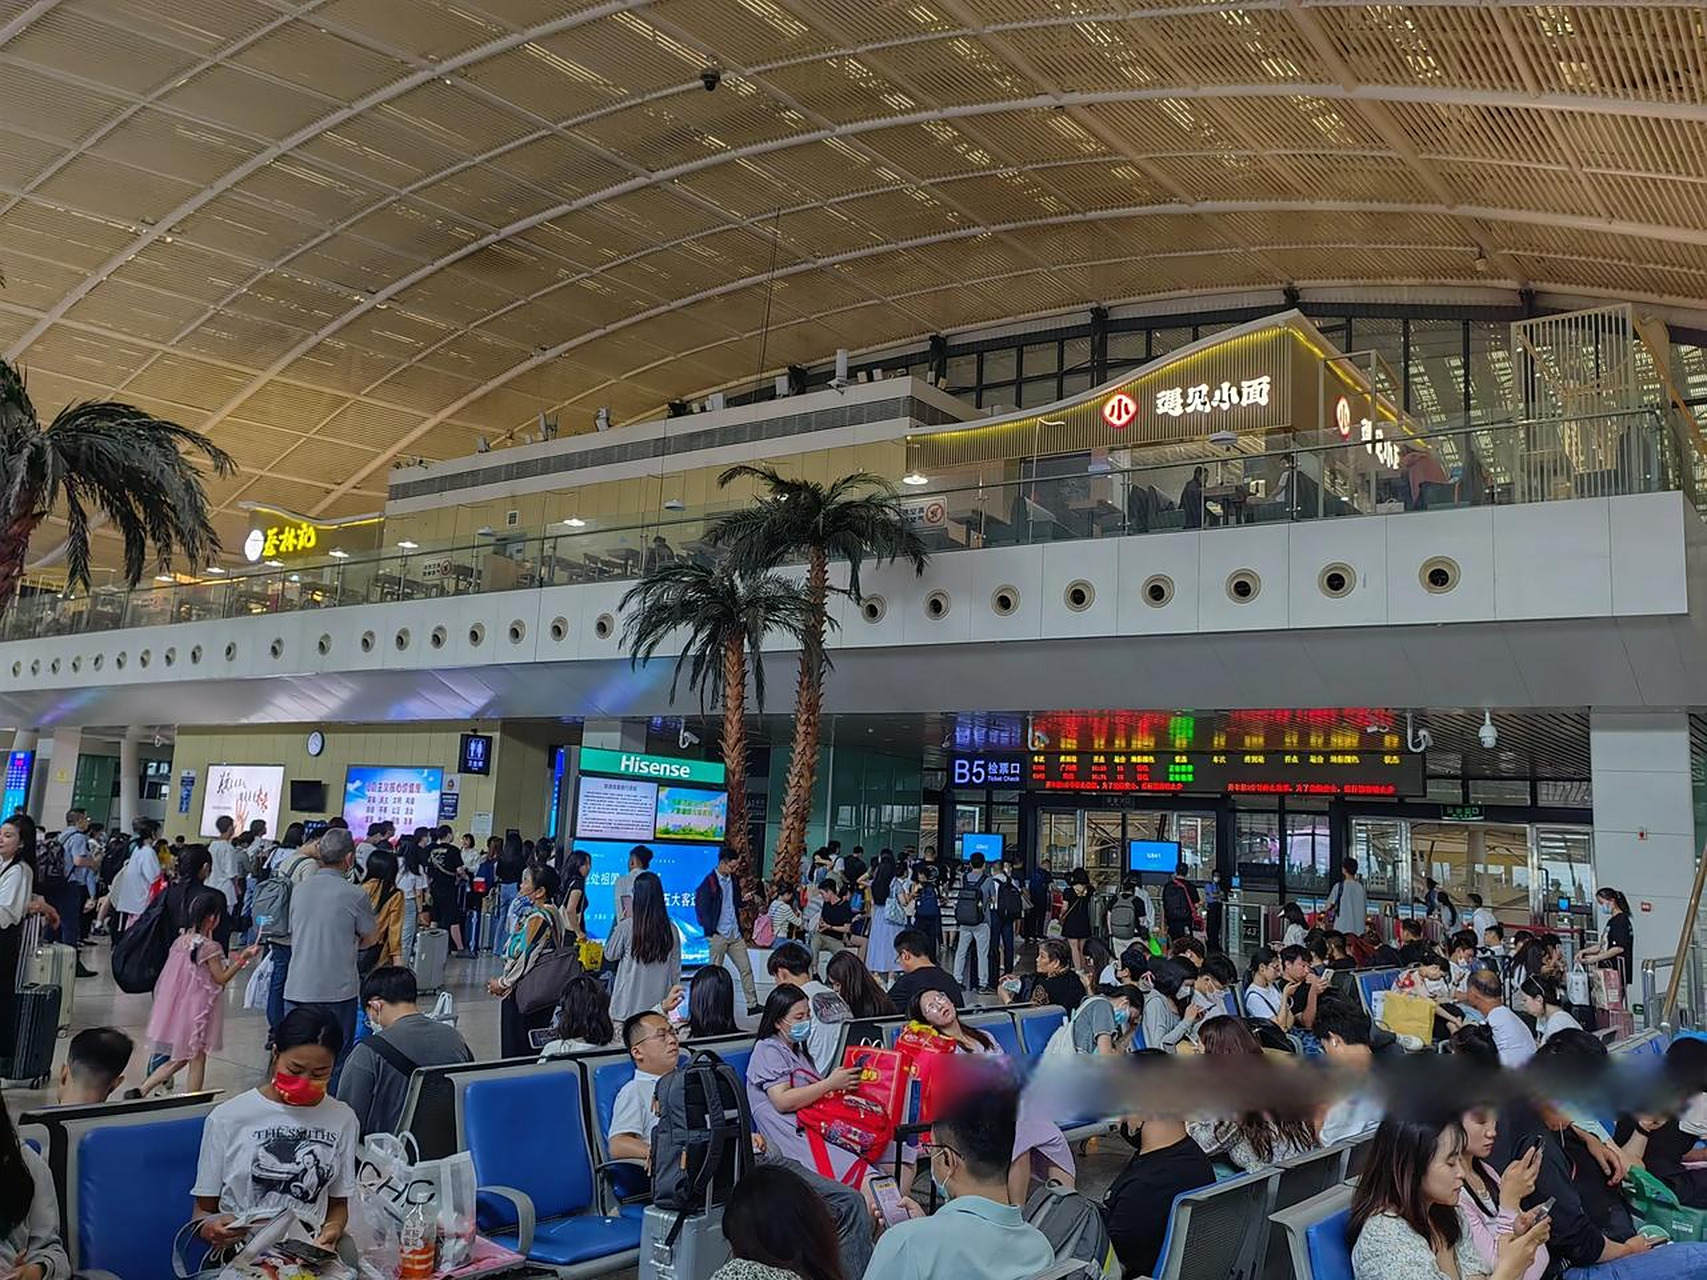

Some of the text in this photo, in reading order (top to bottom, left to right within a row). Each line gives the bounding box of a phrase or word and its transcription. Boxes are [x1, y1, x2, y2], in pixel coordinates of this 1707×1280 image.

[1155, 375, 1272, 417] 遇见小面
[620, 754, 691, 778] Hisense
[954, 759, 985, 784] B5
[987, 761, 1020, 775] 检票口
[987, 775, 1020, 783] Ticket Check
[253, 1126, 338, 1143] THE SMITHS
